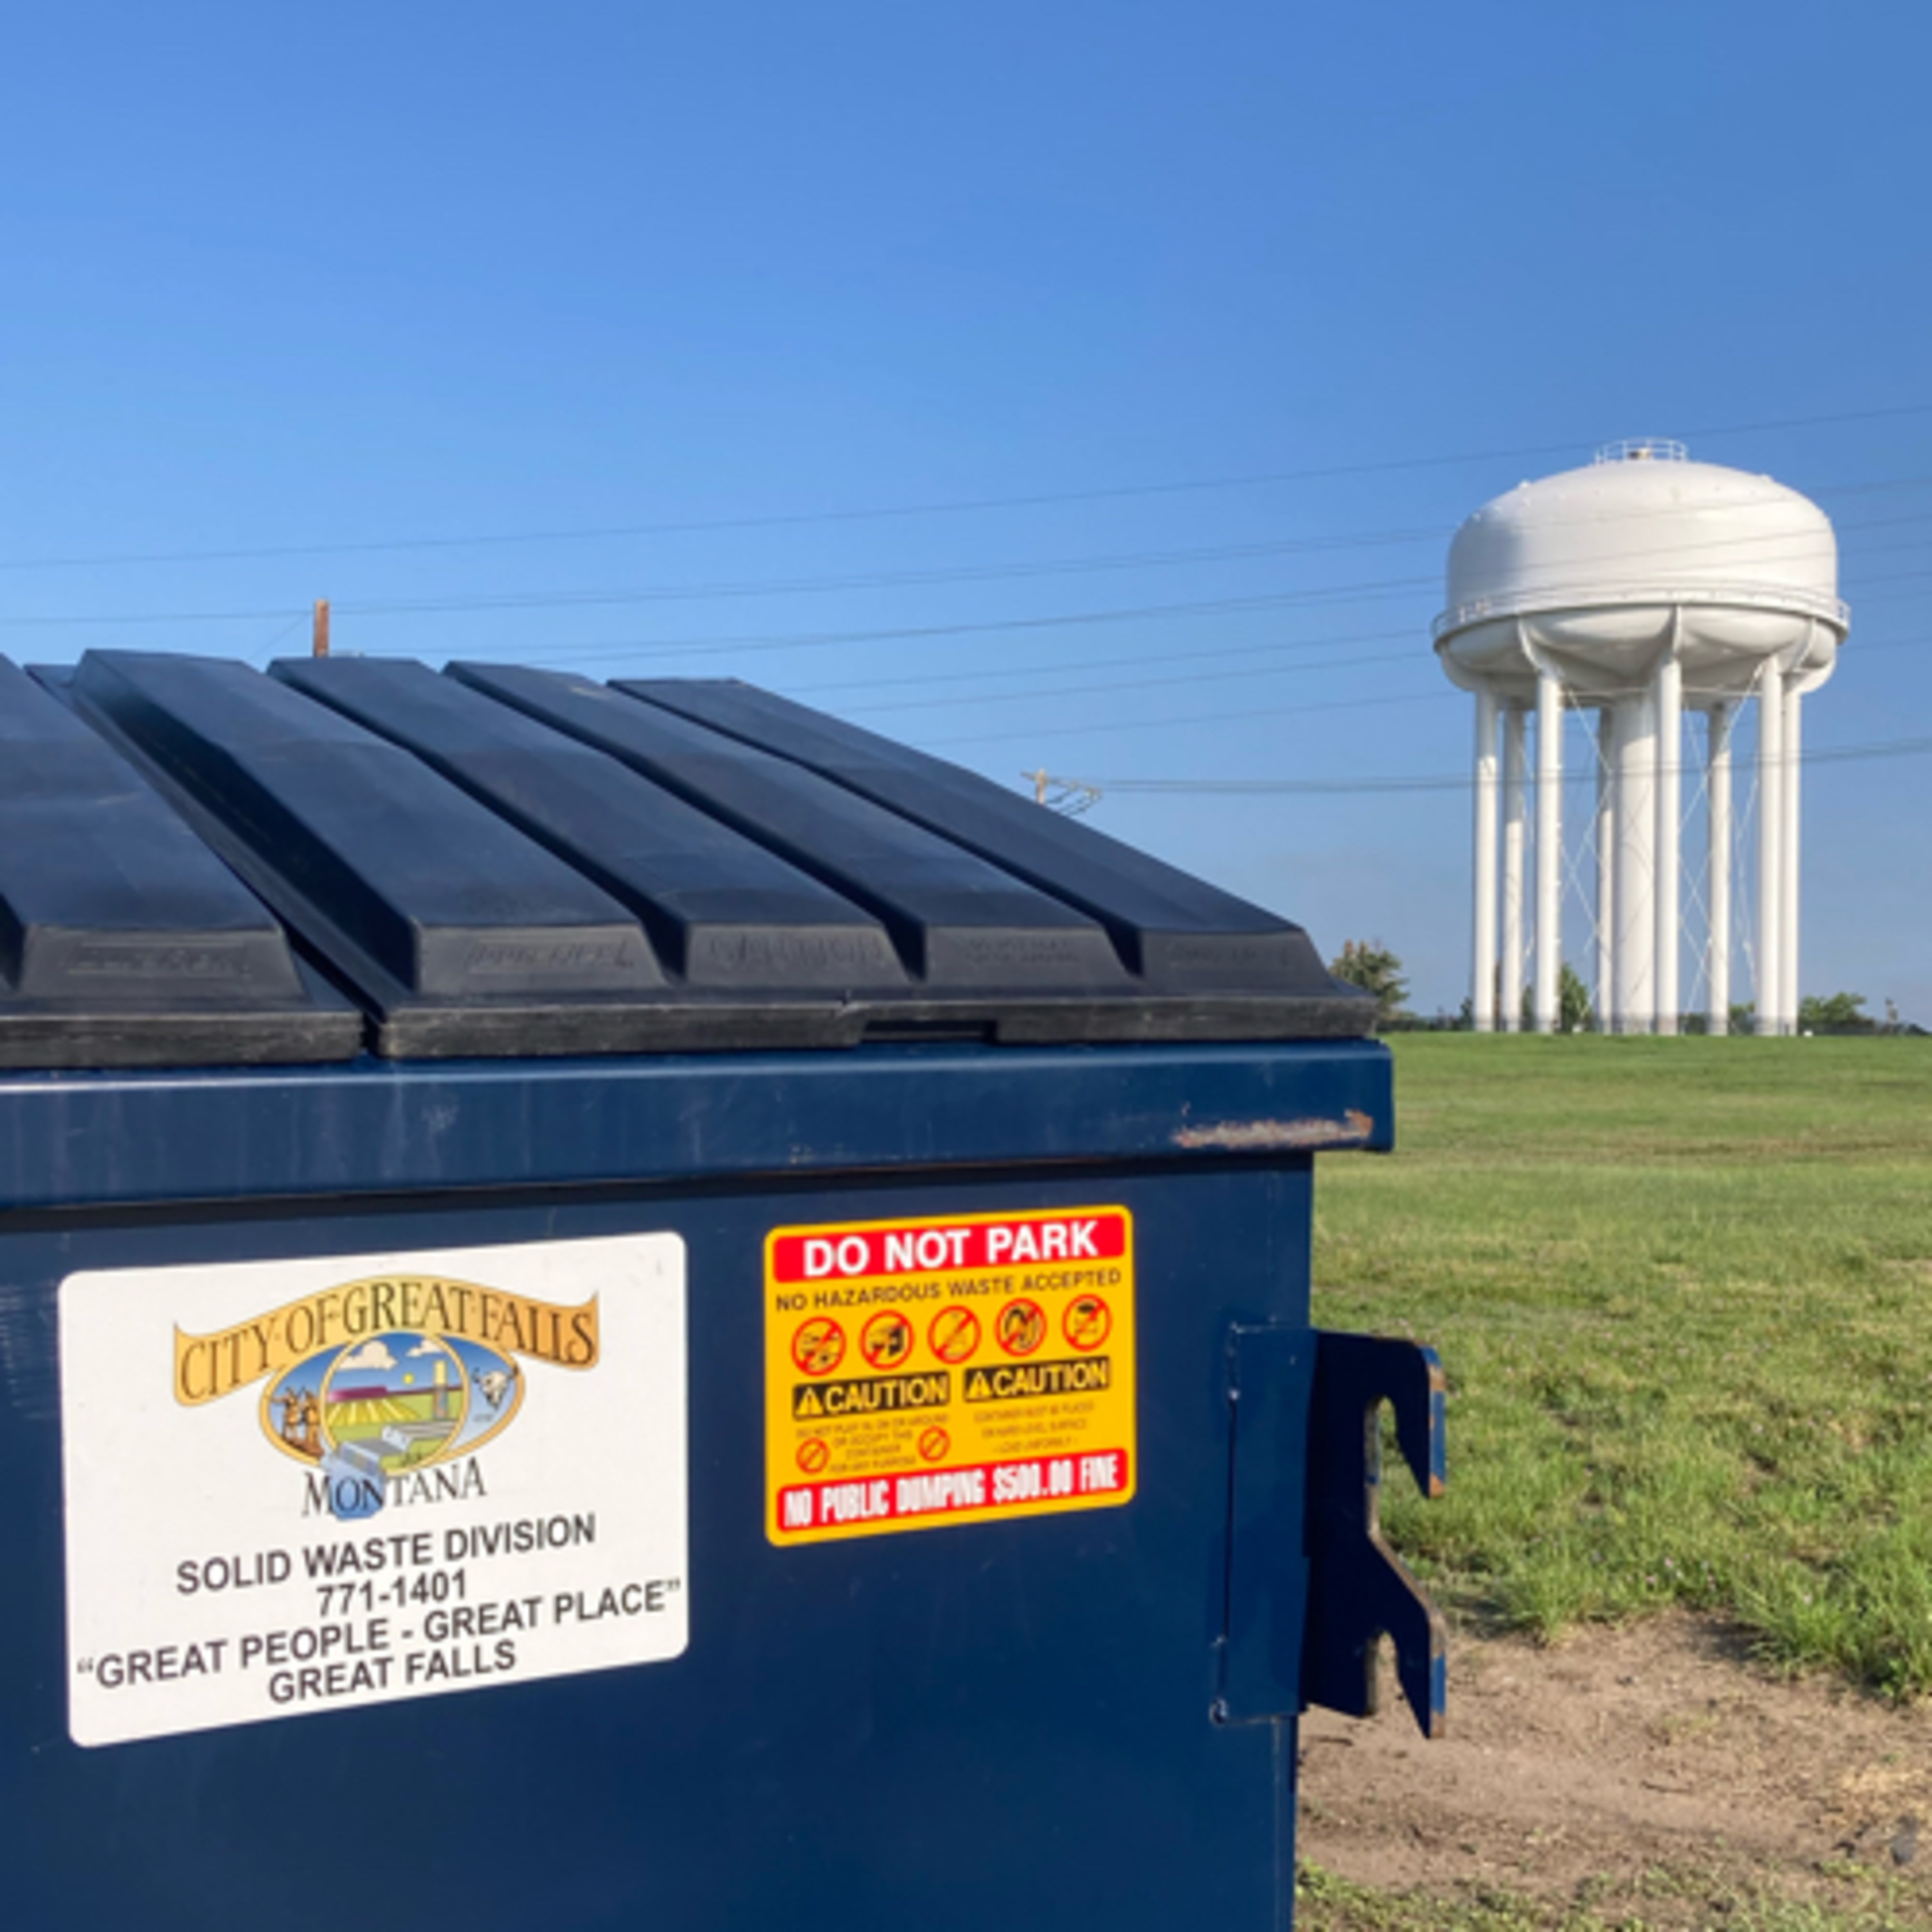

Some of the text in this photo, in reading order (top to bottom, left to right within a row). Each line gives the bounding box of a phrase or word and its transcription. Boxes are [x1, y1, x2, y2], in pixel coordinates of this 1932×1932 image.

[804, 1220, 1099, 1278] DO NOT PARK
[776, 1267, 1122, 1312] NO HAZARDOUS WASTE ACCEPTED
[180, 1282, 595, 1400] CITY OF GREAT FALLS
[824, 1375, 949, 1414] CAUTION
[993, 1359, 1108, 1397] CAUTION
[301, 1457, 488, 1518] MONTANA
[784, 1488, 813, 1528] NO
[822, 1479, 890, 1524] PUBLIC
[896, 1467, 986, 1513] DUMPING
[1081, 1453, 1118, 1492] FINE
[176, 1513, 596, 1595] SOLID WASTE DIVISION
[316, 1567, 466, 1617] 771-1401
[240, 1617, 389, 1669] PEOPLE
[423, 1596, 542, 1643] GREAT
[269, 1639, 516, 1704] GREAT FALLS
